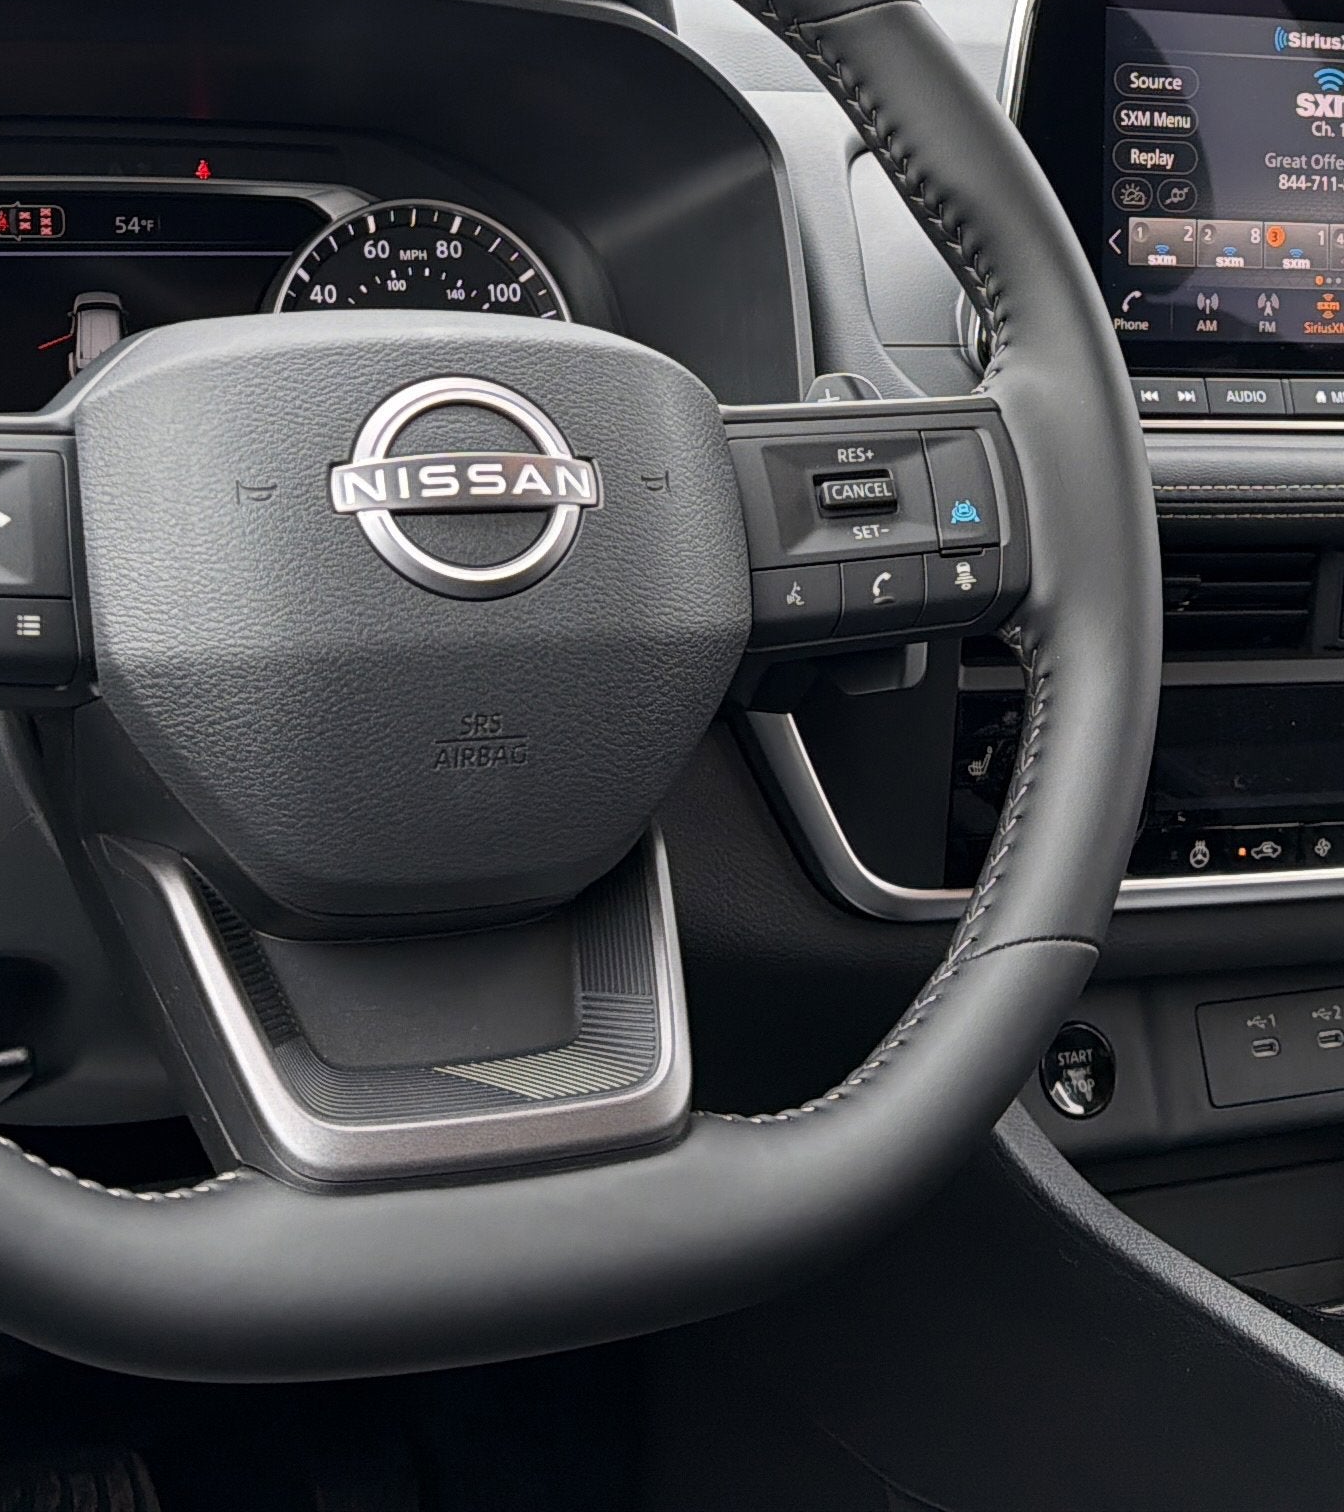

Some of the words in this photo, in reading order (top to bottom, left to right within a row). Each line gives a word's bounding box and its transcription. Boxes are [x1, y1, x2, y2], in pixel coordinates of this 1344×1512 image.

[1129, 71, 1183, 91] Source
[1120, 110, 1151, 127] SXM
[1153, 111, 1191, 129] Menu
[1311, 121, 1336, 137] Ch.
[1130, 148, 1175, 170] Replay
[1264, 152, 1307, 169] Great
[1136, 226, 1144, 239] 1
[1183, 225, 1194, 242] 2
[1203, 228, 1212, 241] 2
[1250, 227, 1261, 244] 8
[1271, 229, 1279, 243] 3
[1318, 230, 1325, 246] 1
[1336, 233, 1344, 245] 4
[363, 239, 391, 259] 60
[399, 249, 428, 262] MPH
[435, 239, 463, 259] 80
[309, 284, 337, 303] 40
[386, 279, 407, 292] 100
[446, 288, 466, 300] 140
[487, 283, 521, 302] 100
[1114, 318, 1149, 331] Phone
[1196, 320, 1218, 332] AM
[1258, 321, 1277, 333] FM
[1225, 389, 1267, 403] AUDIO
[837, 447, 875, 463] RES+
[342, 462, 592, 505] NISSAN
[831, 482, 893, 500] CANCEL
[460, 713, 502, 736] SRS
[434, 743, 528, 769] AIRBAG
[1057, 1048, 1093, 1066] START
